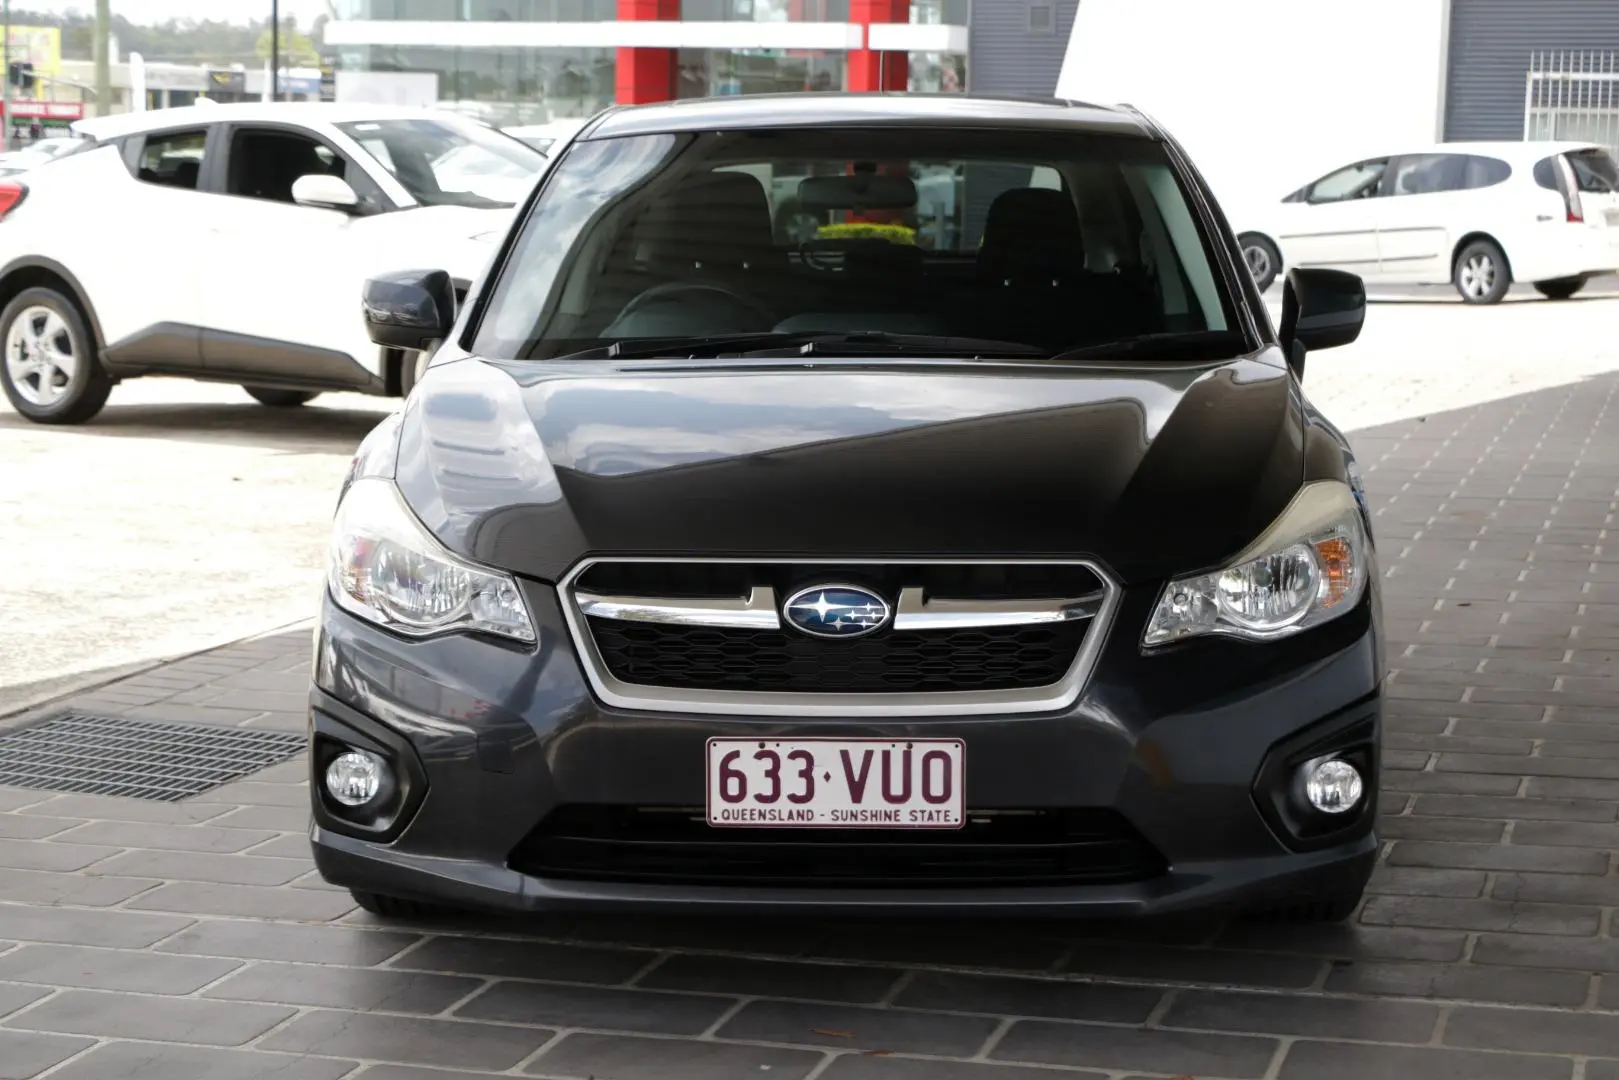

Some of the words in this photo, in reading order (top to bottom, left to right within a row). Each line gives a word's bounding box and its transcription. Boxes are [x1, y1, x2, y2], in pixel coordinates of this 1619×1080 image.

[721, 808, 814, 822] QUEENSLAND
[830, 810, 900, 823] SUNSHINE
[909, 810, 951, 823] STATE
